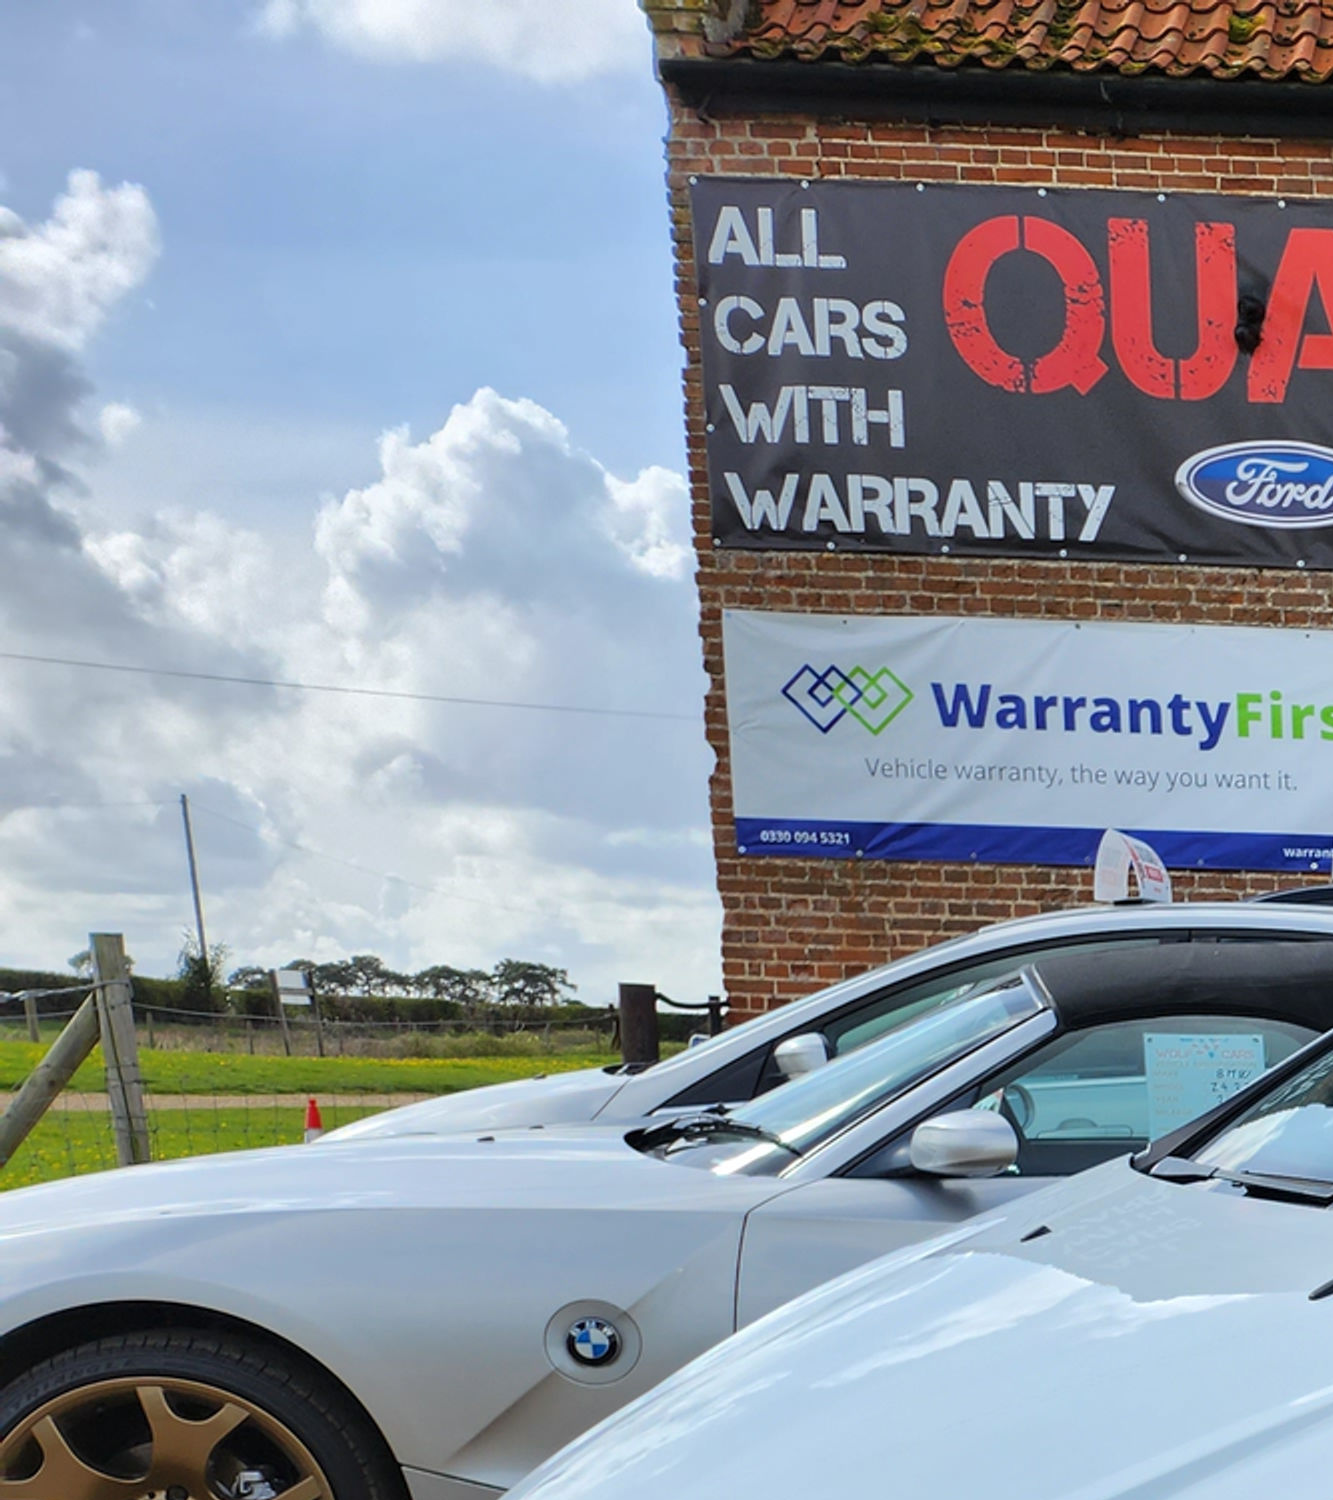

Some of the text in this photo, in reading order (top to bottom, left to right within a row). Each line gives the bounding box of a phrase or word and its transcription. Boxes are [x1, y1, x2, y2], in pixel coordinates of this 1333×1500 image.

[708, 205, 848, 269] ALL
[713, 295, 909, 360] CARS
[718, 383, 906, 448] WITH
[723, 471, 1116, 542] WARRANTY
[864, 757, 1299, 794] Vehicle warranty, the way you want it.
[760, 829, 850, 845] 0330 094 5321
[569, 1319, 616, 1337] BMW
